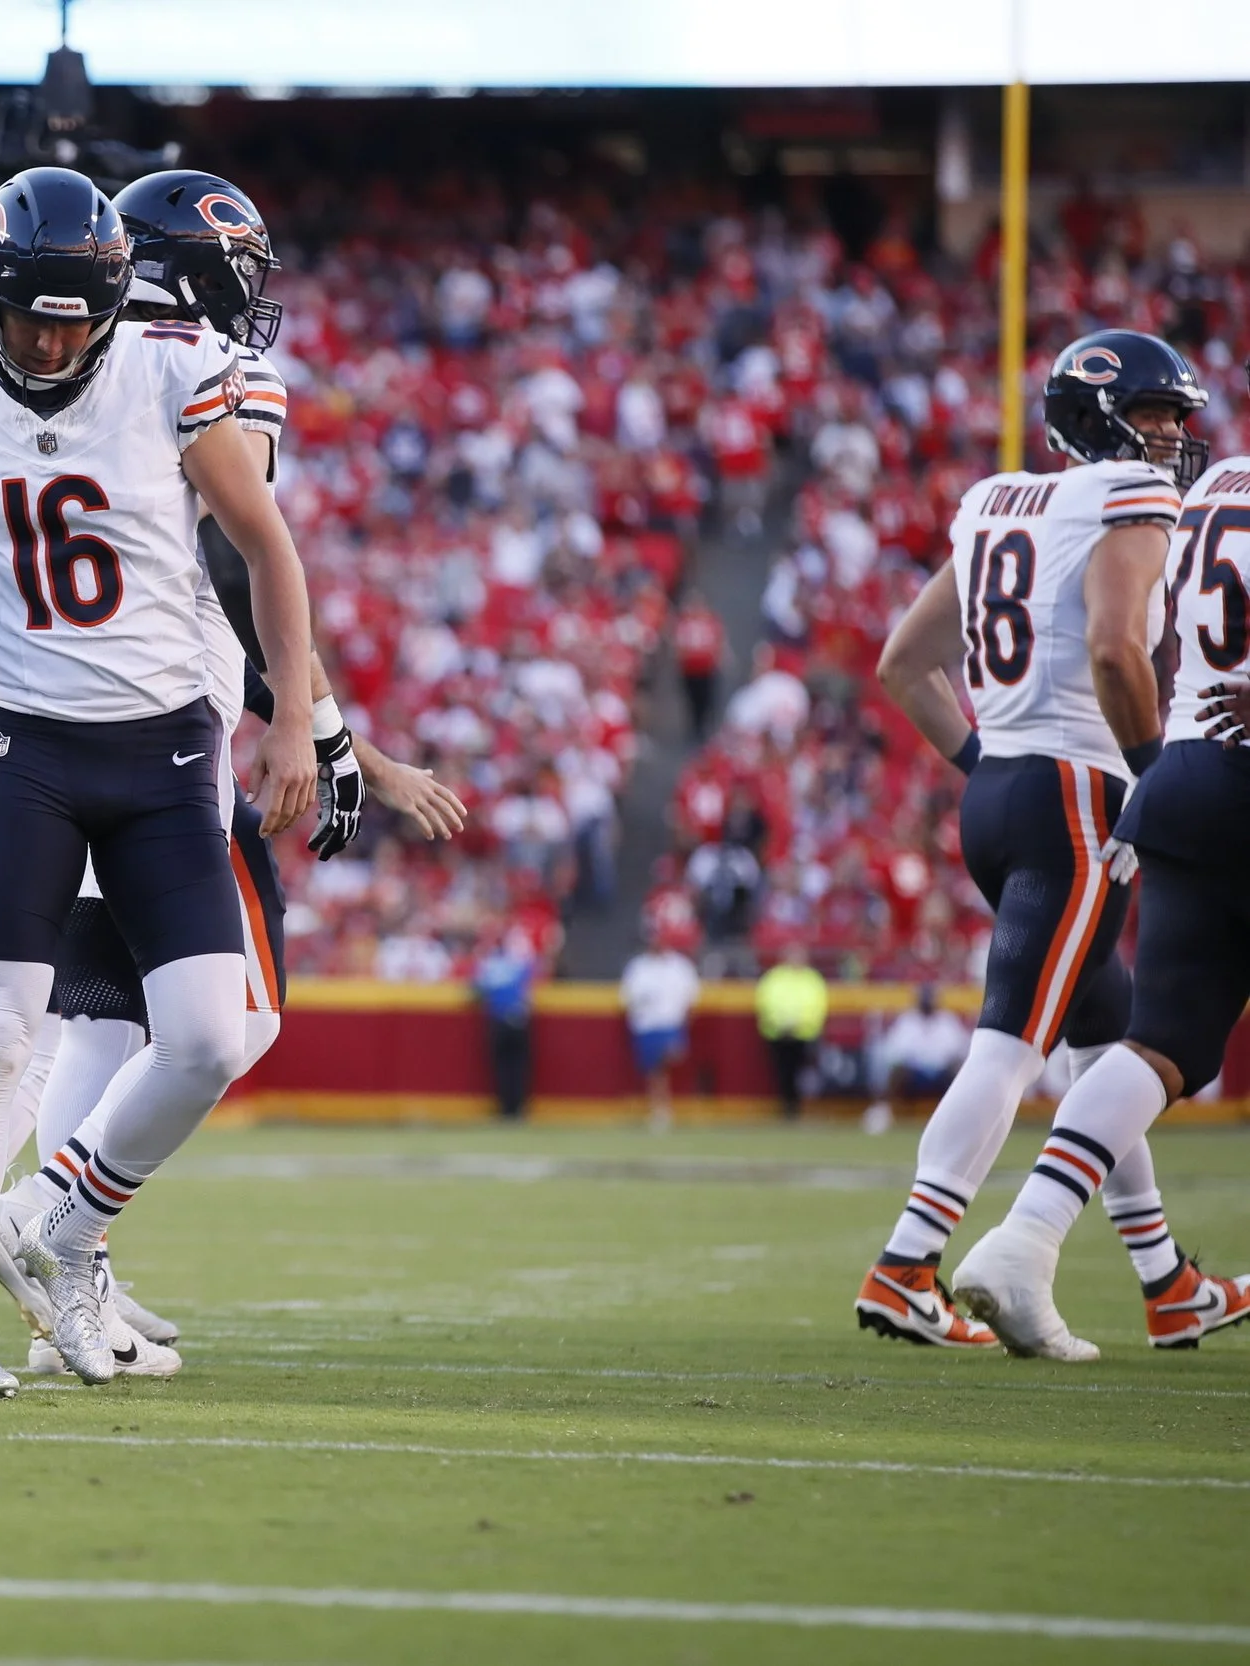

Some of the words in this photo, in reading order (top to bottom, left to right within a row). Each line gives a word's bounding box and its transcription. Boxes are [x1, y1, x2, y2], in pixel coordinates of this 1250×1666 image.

[41, 301, 82, 311] BEARS
[1, 474, 124, 630] 16
[966, 529, 1036, 688] 18
[1171, 504, 1250, 671] 75
